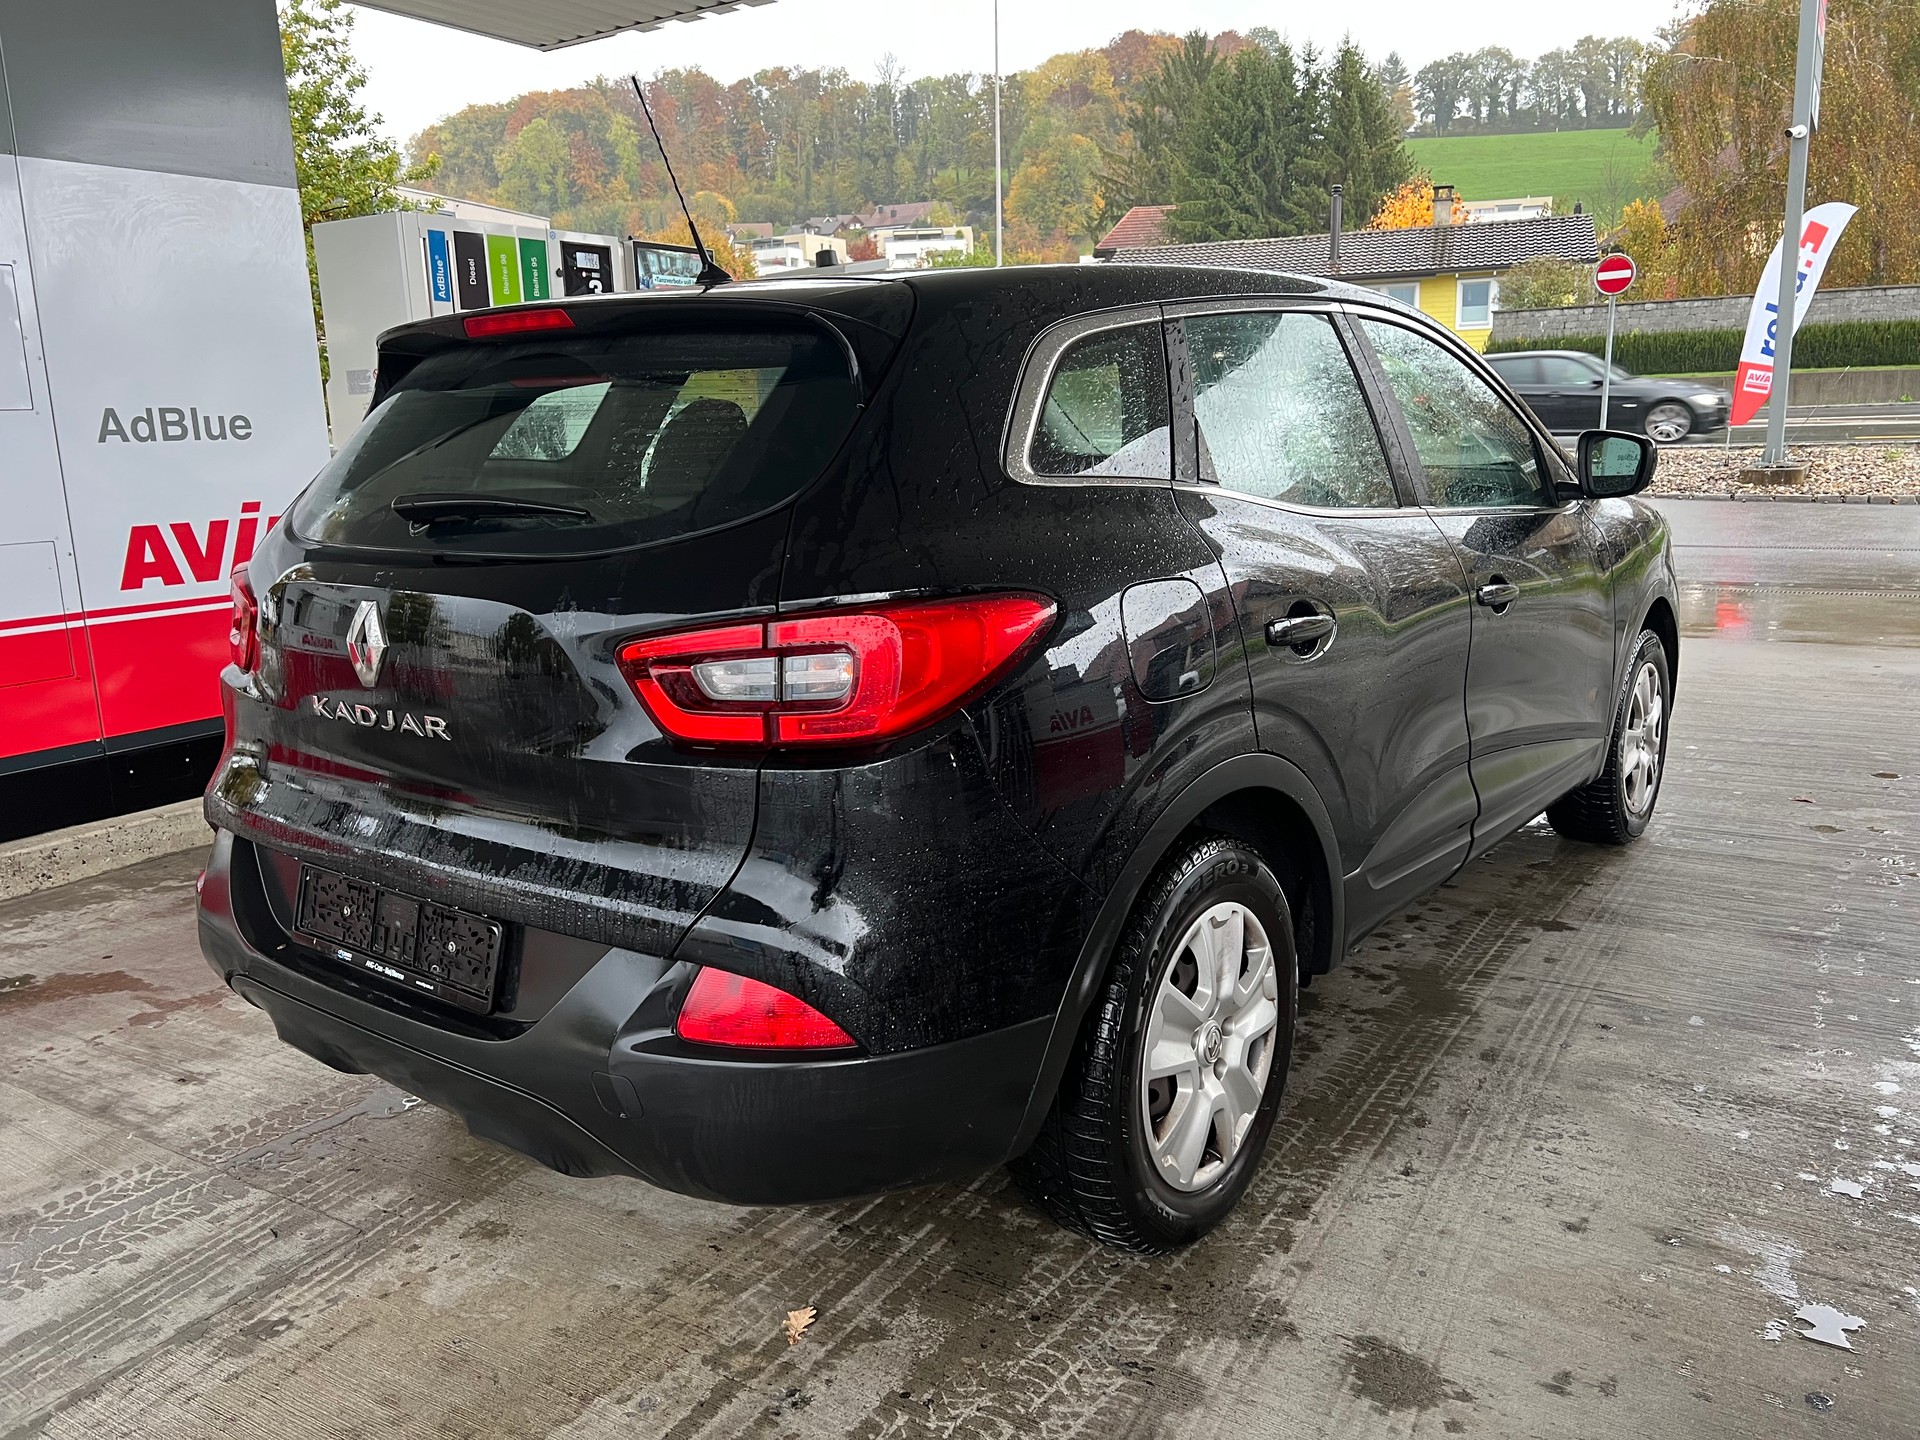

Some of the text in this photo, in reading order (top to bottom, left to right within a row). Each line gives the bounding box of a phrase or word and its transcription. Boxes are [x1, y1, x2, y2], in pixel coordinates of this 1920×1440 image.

[468, 258, 477, 285] Diesel
[531, 256, 540, 297] Bleifrei 95
[98, 407, 252, 443] AdBlue
[312, 695, 453, 741] KADJAR
